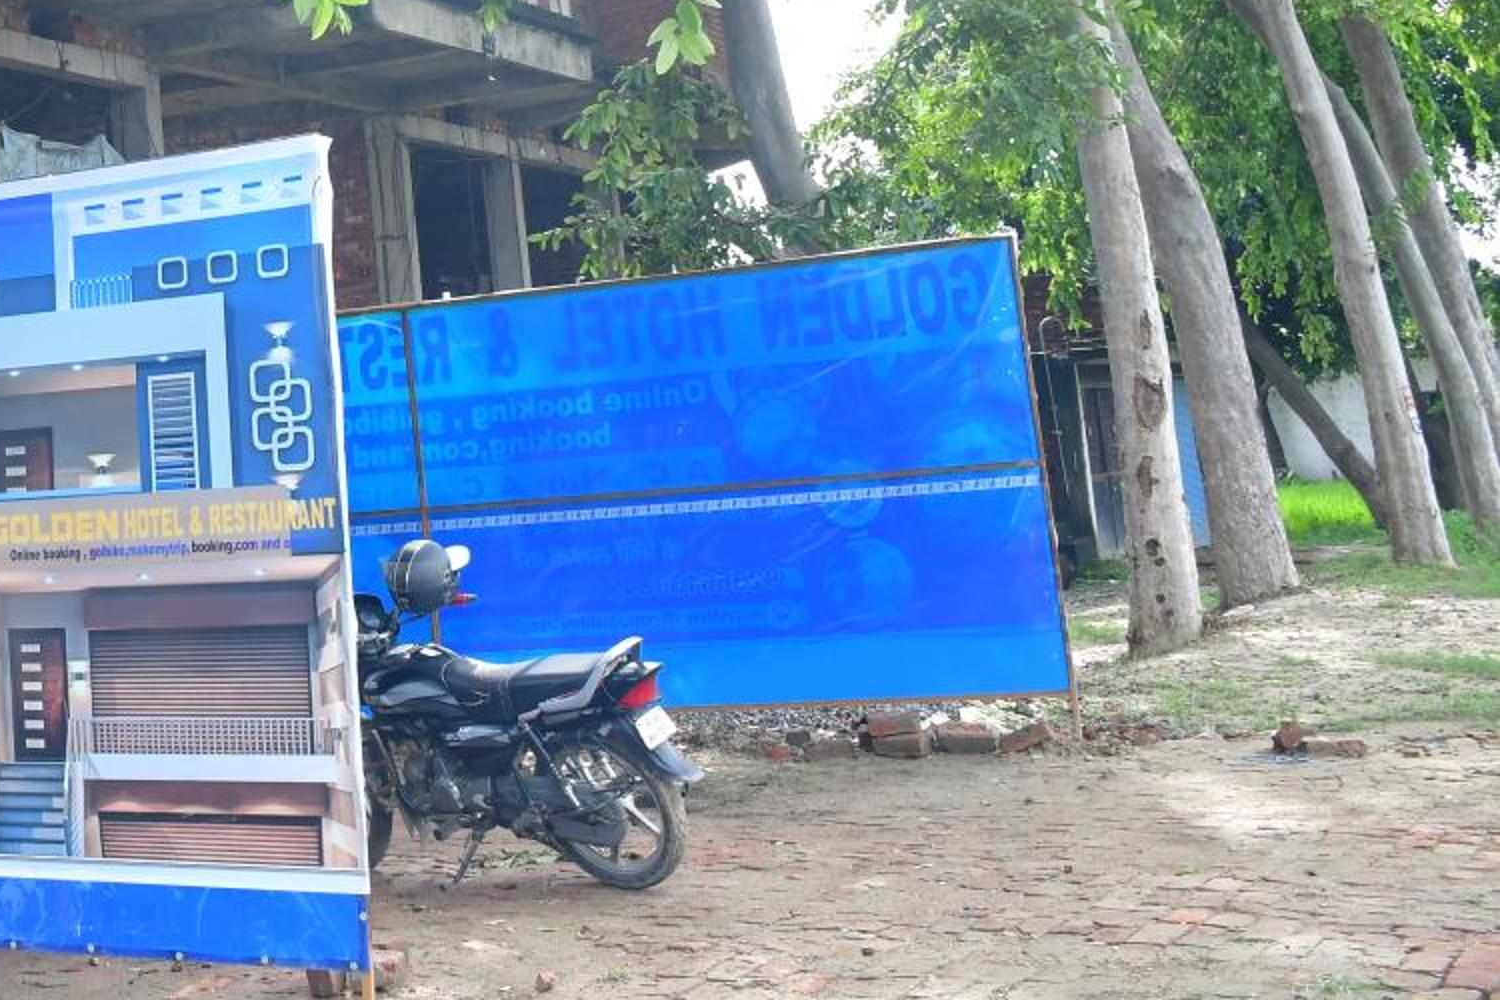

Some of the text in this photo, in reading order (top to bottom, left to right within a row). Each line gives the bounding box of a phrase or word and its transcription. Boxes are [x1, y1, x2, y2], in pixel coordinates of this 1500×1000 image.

[123, 505, 183, 540] HOTEL
[189, 504, 203, 537] &
[208, 496, 337, 536] RESTAURANT
